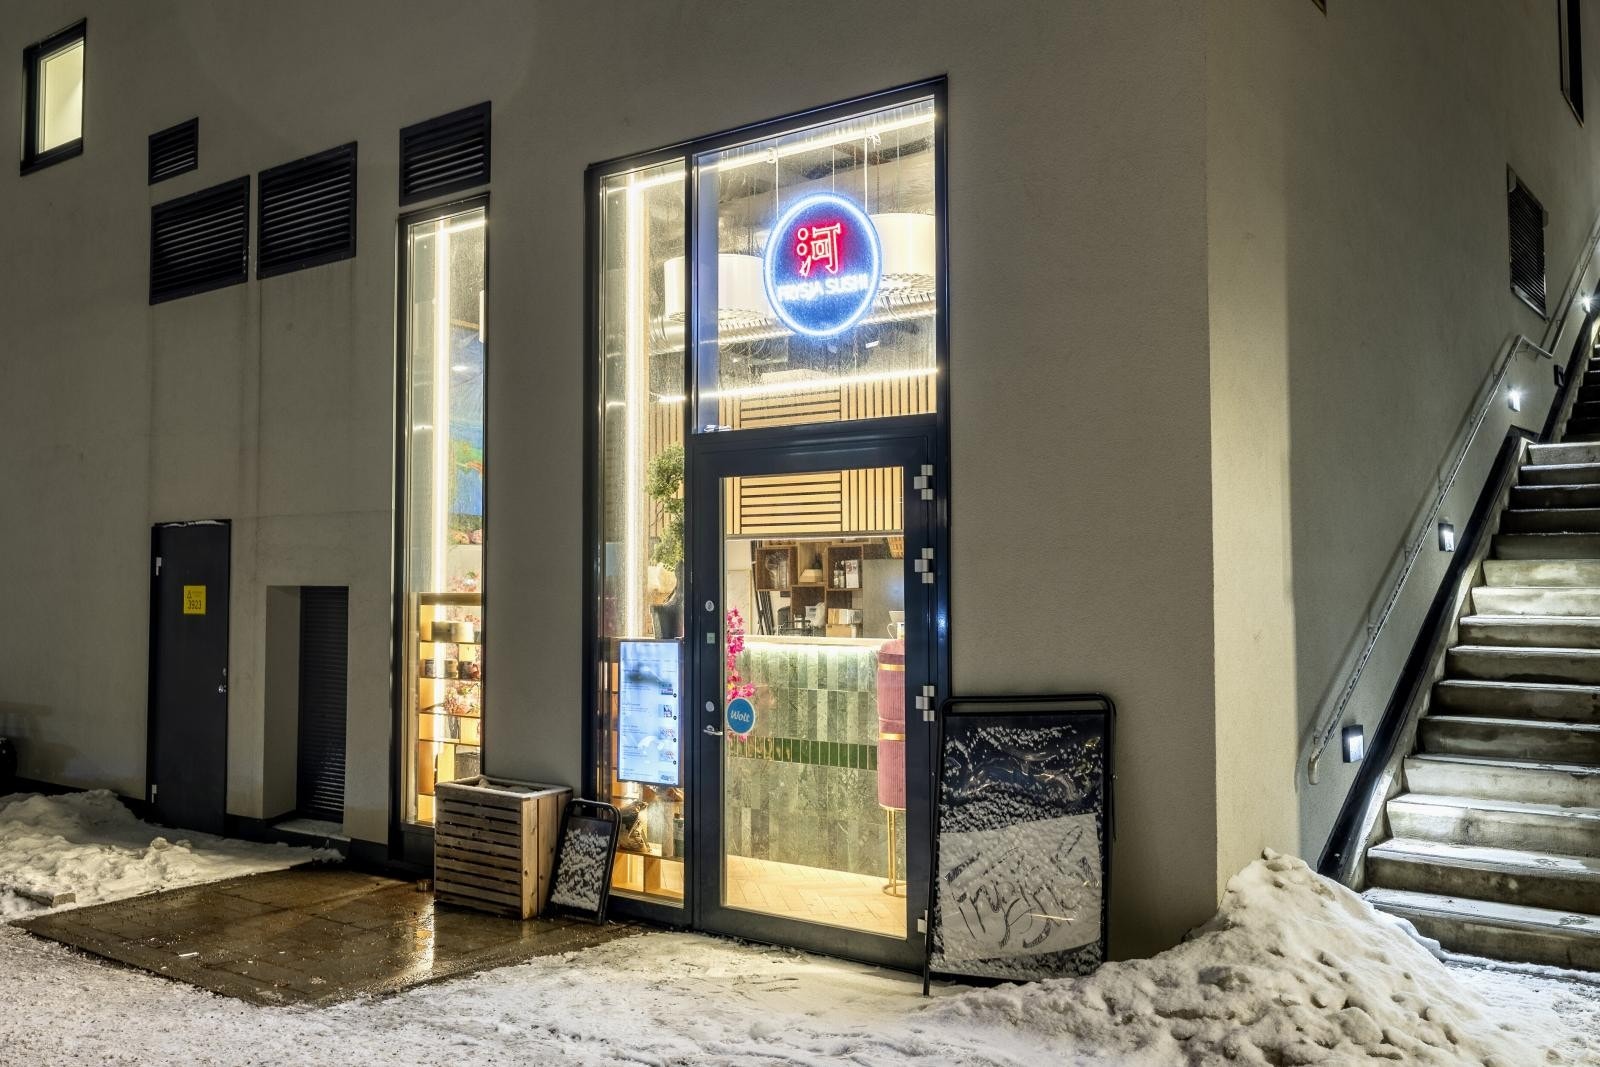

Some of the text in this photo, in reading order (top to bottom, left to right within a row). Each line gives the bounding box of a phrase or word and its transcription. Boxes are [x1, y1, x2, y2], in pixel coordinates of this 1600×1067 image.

[797, 223, 841, 277] 河
[825, 273, 869, 295] SUSHI
[730, 710, 750, 722] Wolt
